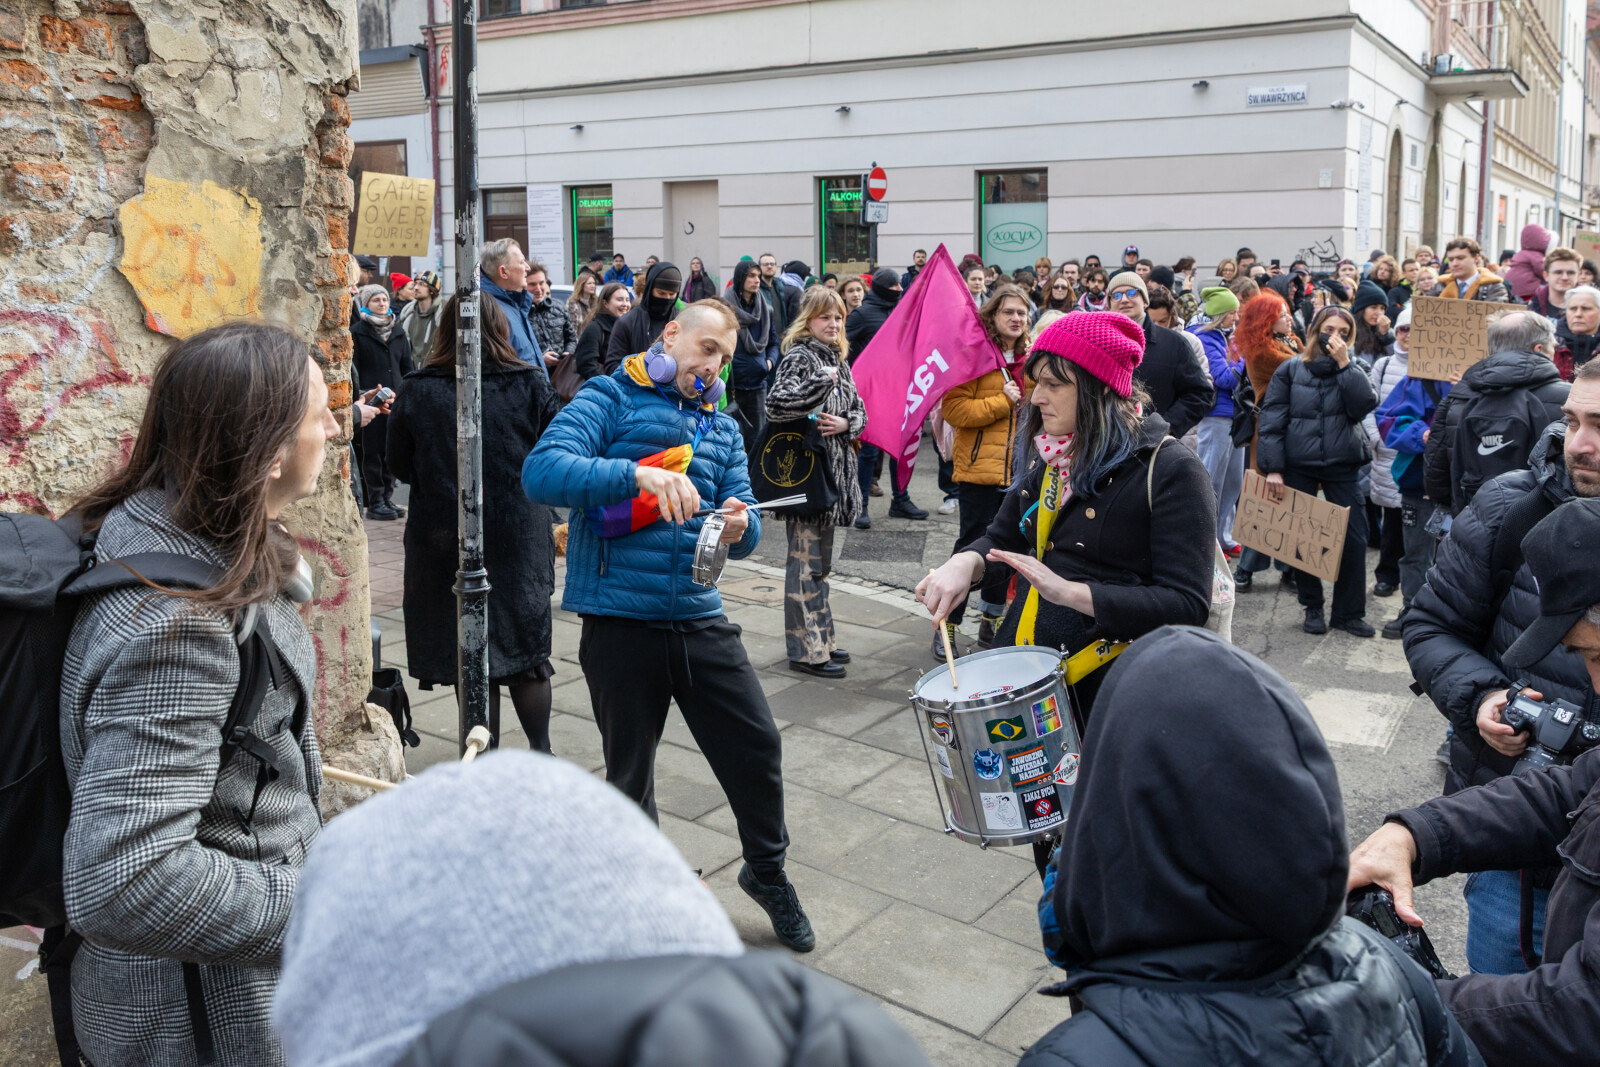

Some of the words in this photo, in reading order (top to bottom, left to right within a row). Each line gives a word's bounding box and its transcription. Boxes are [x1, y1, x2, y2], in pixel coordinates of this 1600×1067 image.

[366, 177, 429, 202] GAME
[578, 198, 613, 208] DELIKATES
[364, 204, 426, 225] OVER
[365, 226, 424, 240] TOURISM
[992, 230, 1037, 245] KOCYK
[1414, 297, 1457, 316] GDZIE
[1413, 314, 1472, 330] CHODZIĆ
[1414, 329, 1480, 347] TURYŚCI
[1413, 346, 1467, 360] TUTAJ
[1412, 361, 1432, 373] NIC
[1438, 362, 1461, 374] NIE
[1481, 434, 1504, 447] NIKE
[1244, 471, 1281, 506] NIE
[1291, 490, 1343, 535] DLA
[1243, 498, 1342, 548] GENTRYFI
[1238, 517, 1290, 556] KACJI
[1295, 537, 1331, 574] KRK
[1010, 757, 1049, 775] NAPIERDALA
[1011, 749, 1044, 767] JAWORZNO
[1018, 767, 1045, 782] NAZIOLI
[1023, 790, 1042, 803] ZAKAZ
